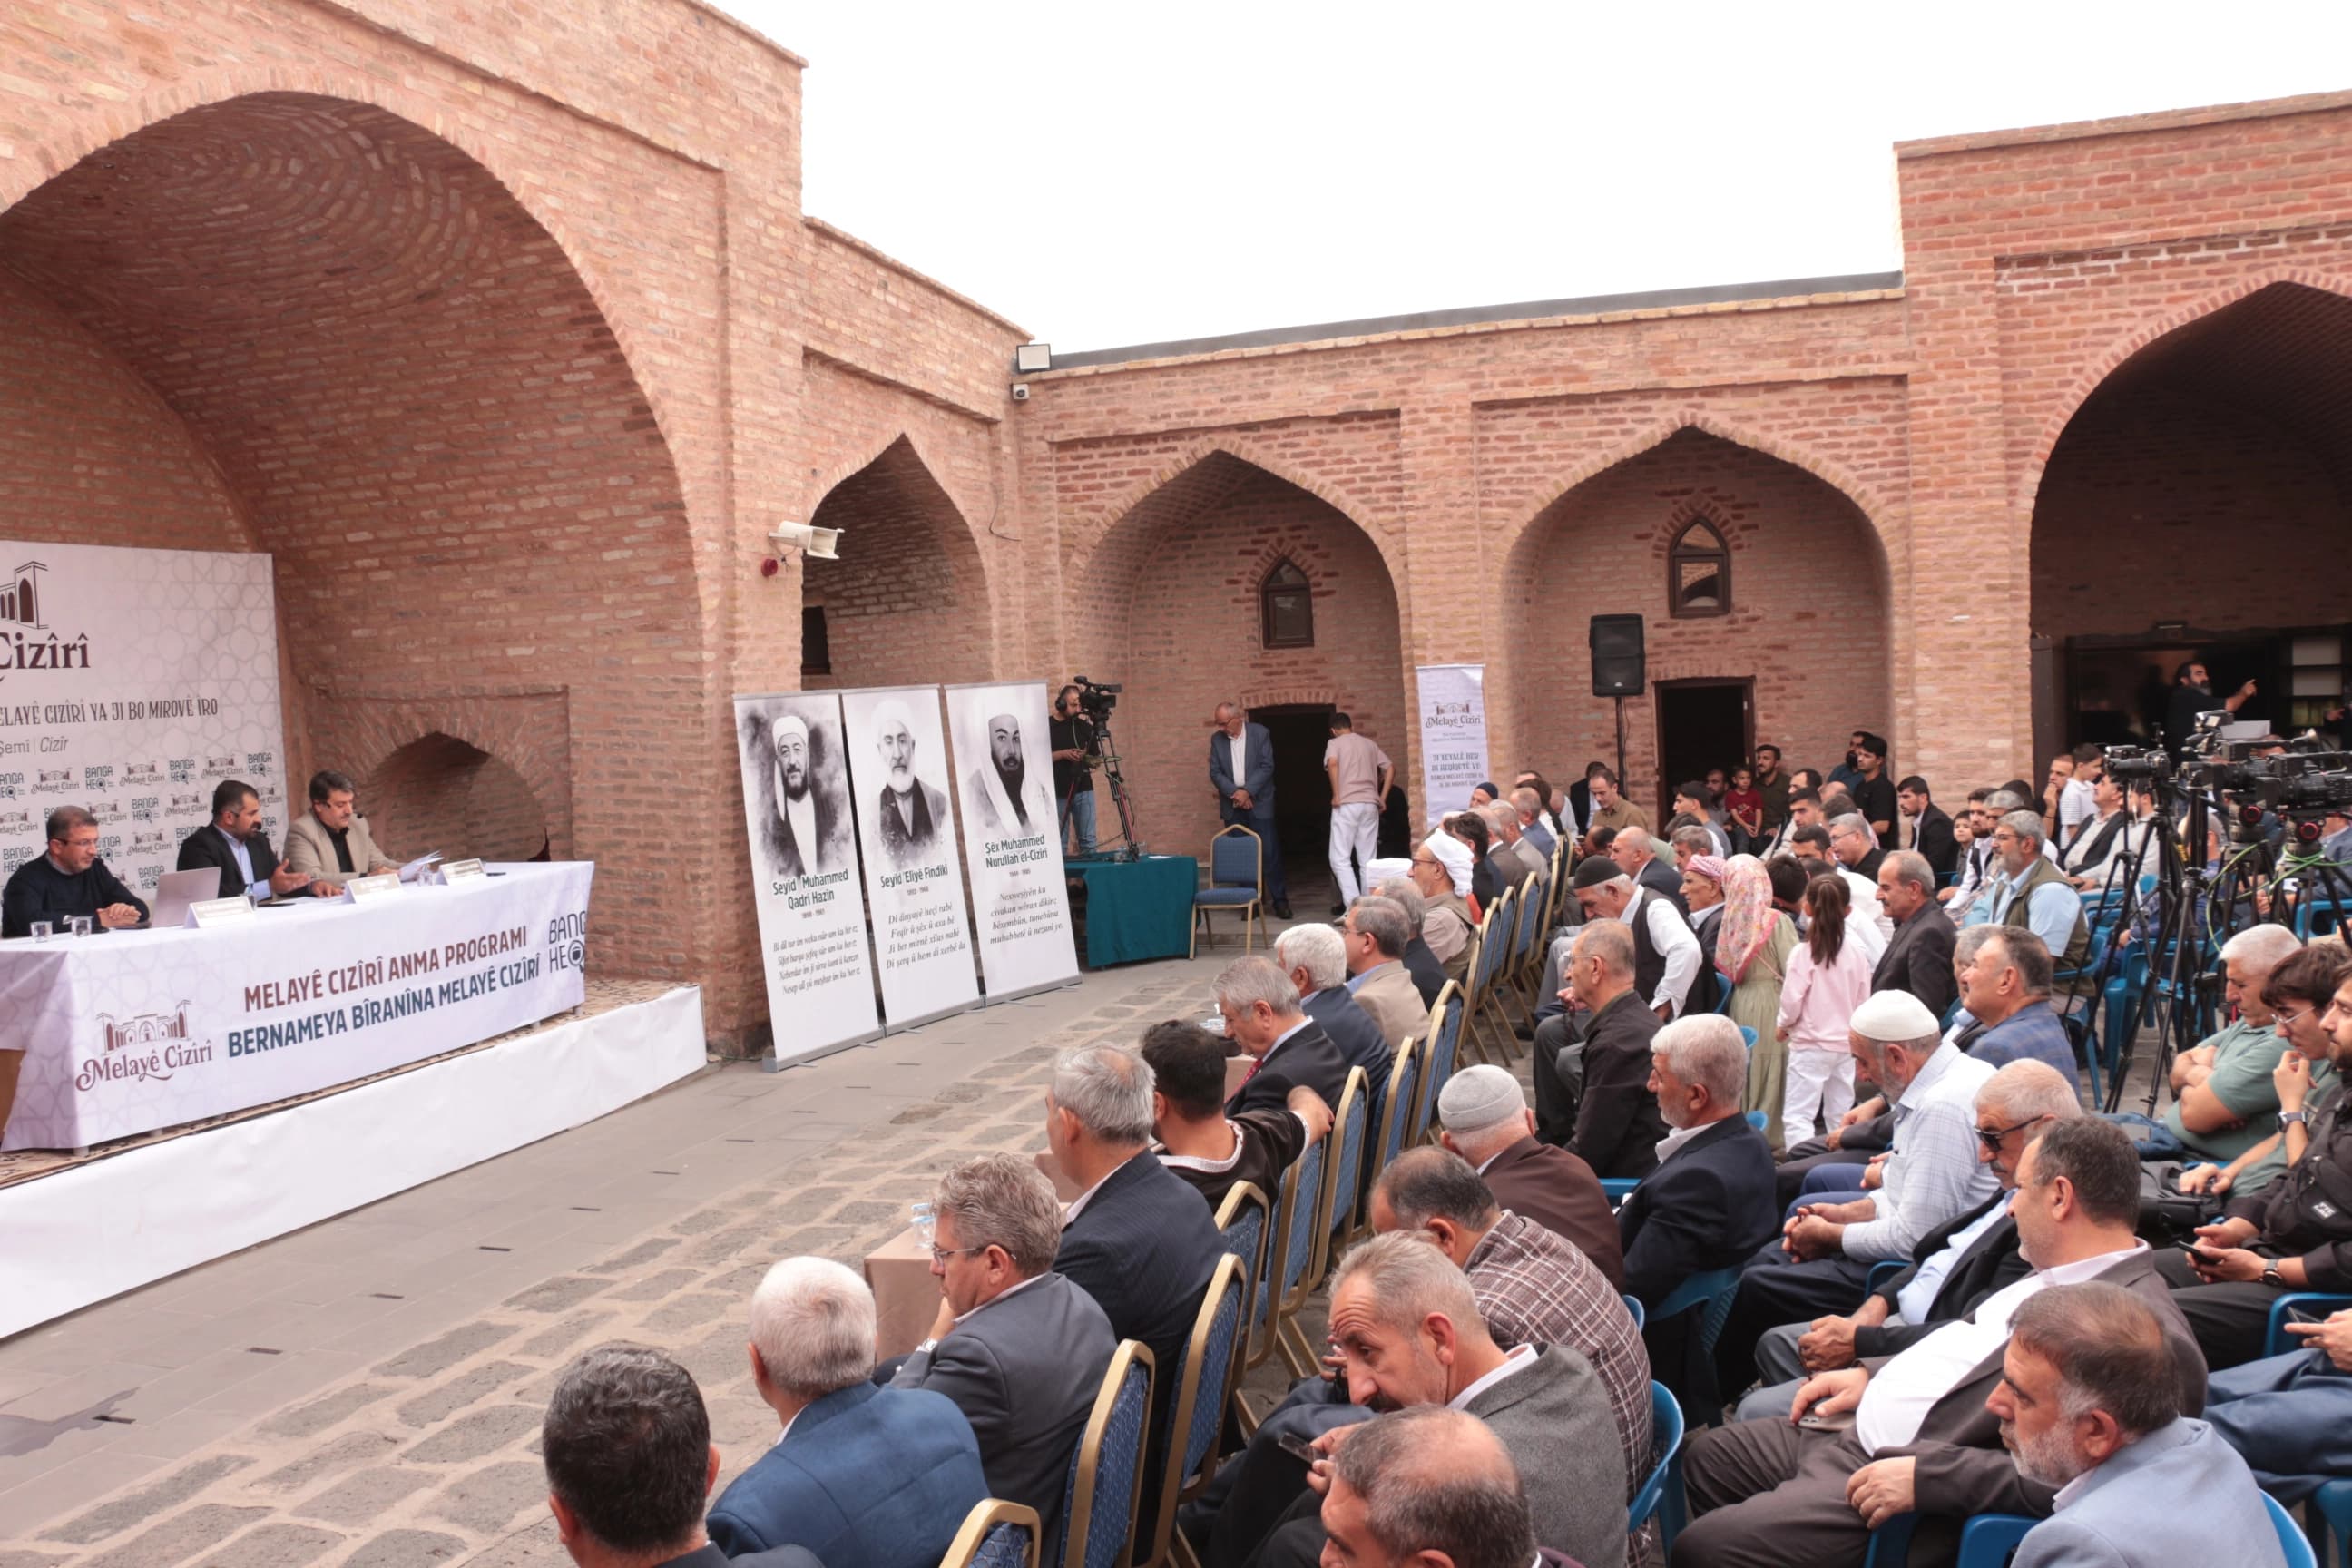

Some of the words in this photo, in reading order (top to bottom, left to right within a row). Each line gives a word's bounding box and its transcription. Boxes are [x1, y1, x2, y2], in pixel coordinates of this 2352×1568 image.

[90, 702, 108, 721] YA
[112, 702, 124, 720] JI
[129, 701, 145, 720] BO
[85, 766, 113, 779] BANGA
[170, 759, 195, 770] BANGA
[132, 798, 159, 809] BANGA
[1001, 834, 1045, 851] Muhammed
[4, 847, 34, 860] BANGA
[986, 853, 1019, 868] Nurullah
[773, 878, 797, 896] Seyid
[802, 868, 849, 888] Muhammed
[881, 873, 902, 888] Seyid
[245, 969, 324, 1013] MELAYÊ
[328, 956, 383, 995] CIZÎRÎ
[388, 949, 440, 982] ANMA
[445, 926, 527, 968] PROGRAMI
[229, 1009, 348, 1058] BERNAMEYA
[352, 987, 435, 1030] BÎRANÎNA
[439, 965, 496, 1007] MELAYÊ
[500, 953, 541, 988] CIZÎRÎ
[75, 1050, 165, 1092] Melayê
[165, 1039, 212, 1068] Cizîrî
